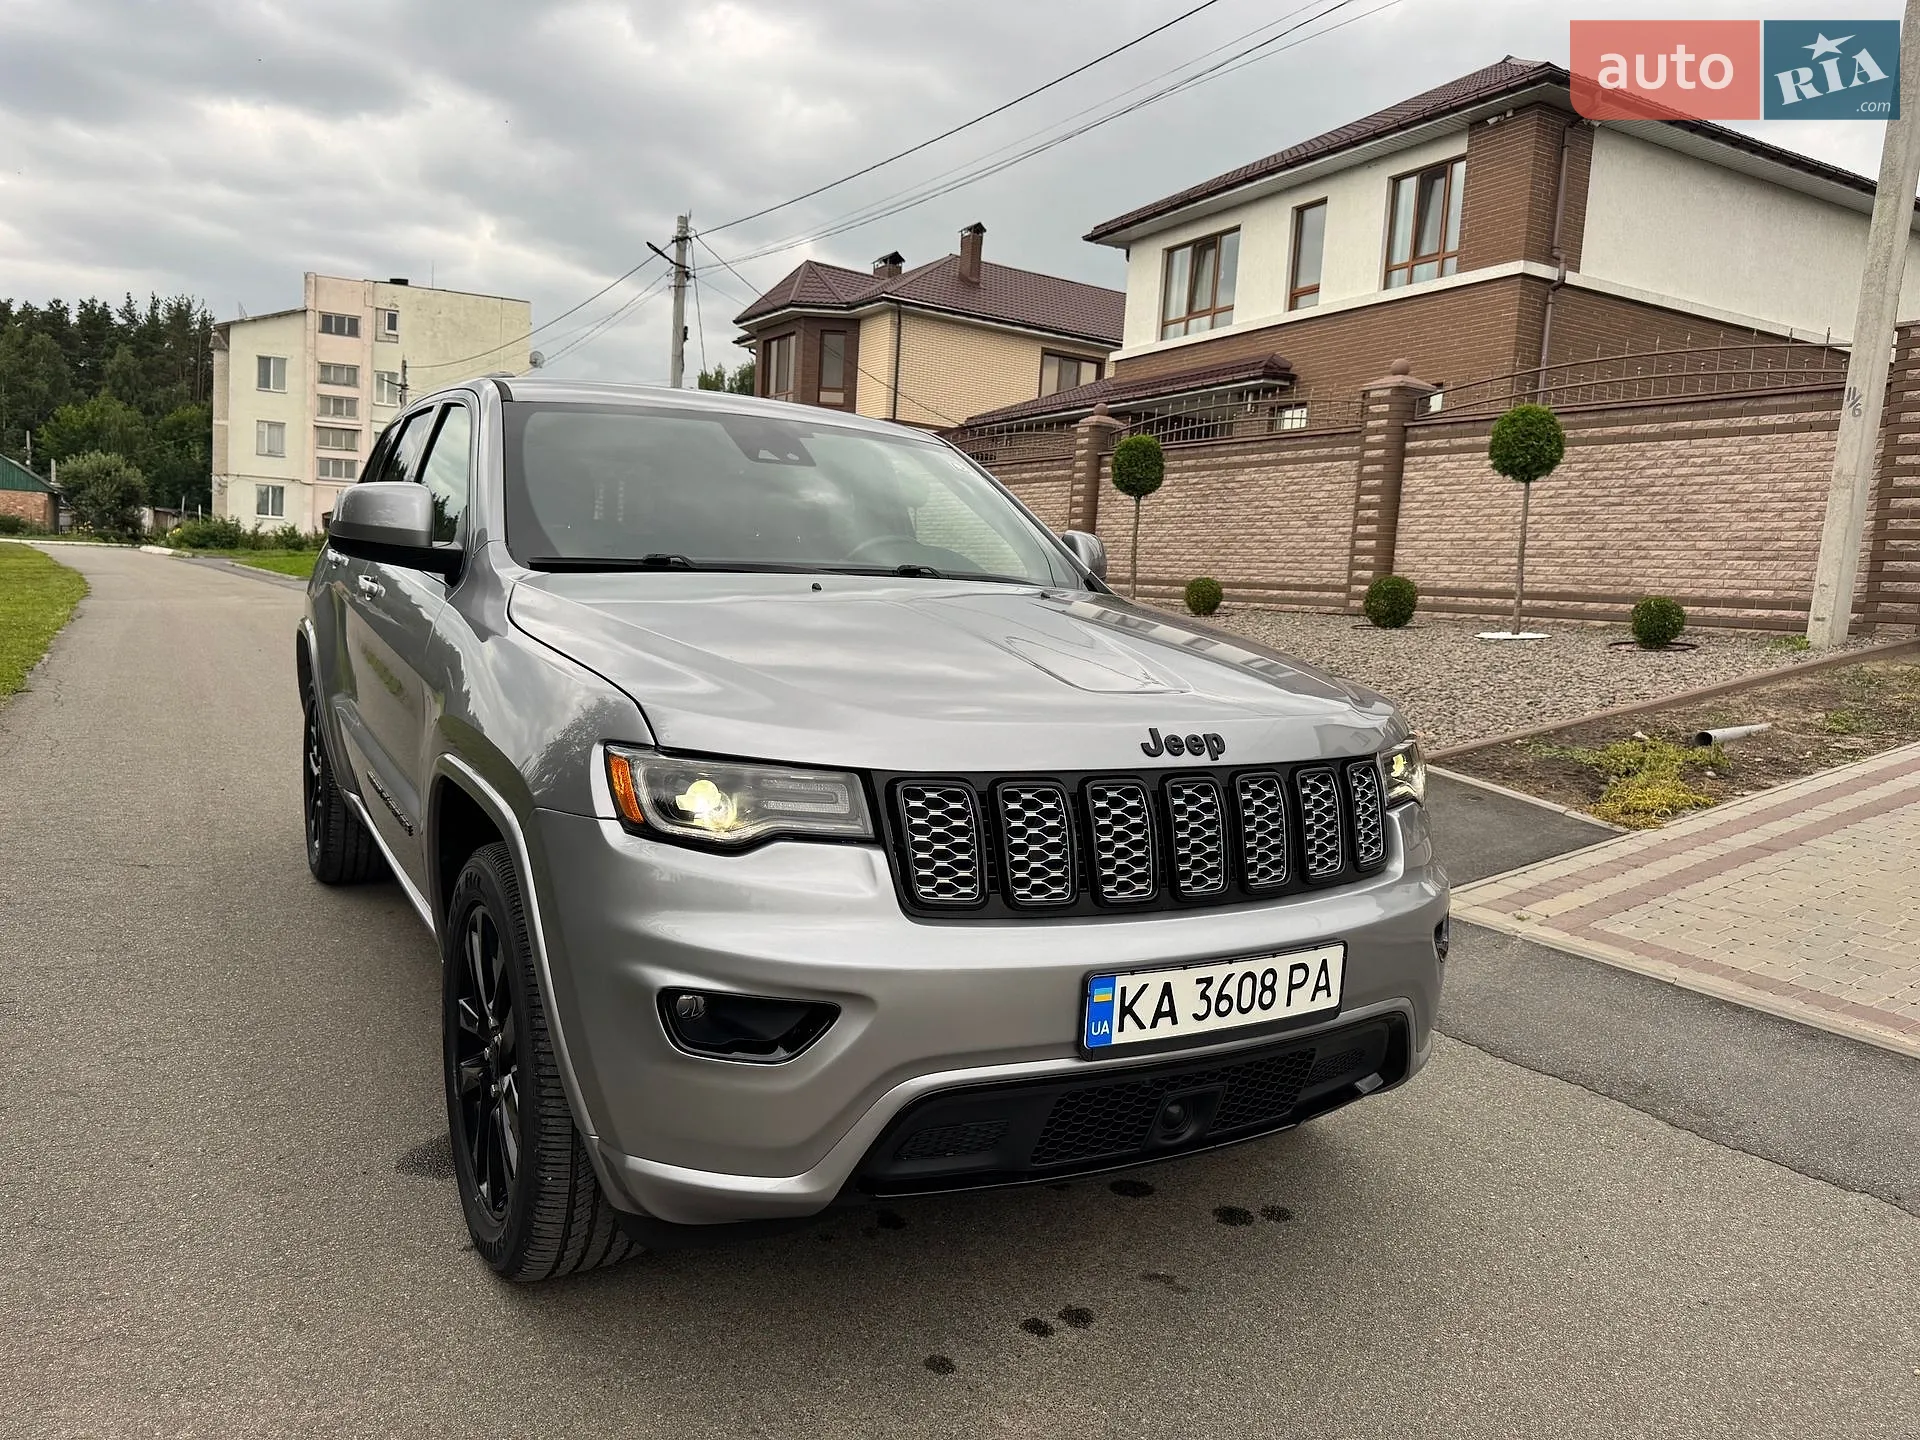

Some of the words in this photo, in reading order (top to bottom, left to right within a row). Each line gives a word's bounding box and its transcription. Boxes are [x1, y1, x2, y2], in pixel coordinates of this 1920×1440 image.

[1140, 727, 1226, 761] Jeep
[1117, 981, 1178, 1033] KA
[1191, 967, 1277, 1022] 3608
[1286, 958, 1332, 1007] PA
[1091, 1020, 1110, 1036] UA
